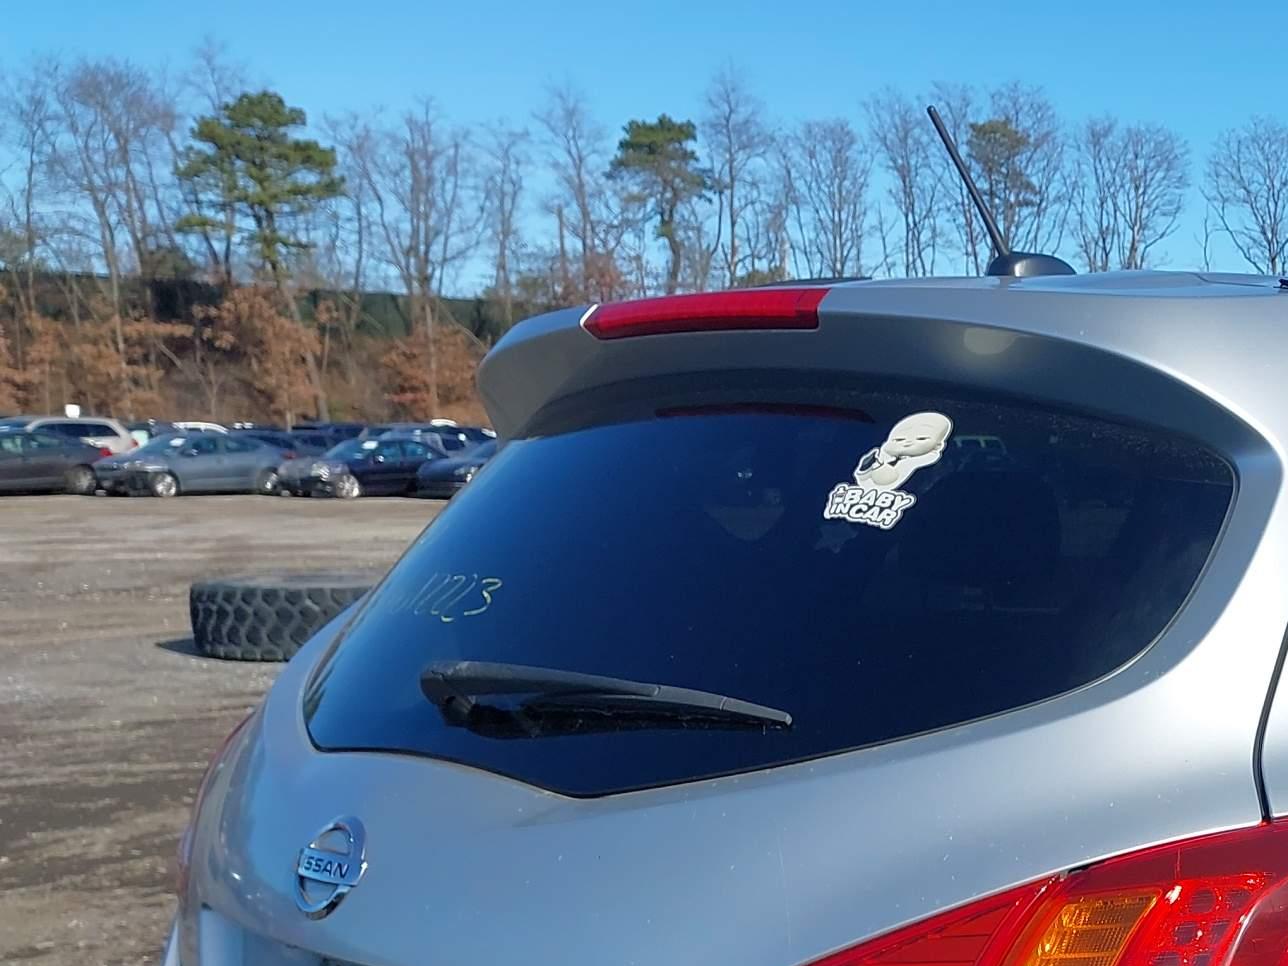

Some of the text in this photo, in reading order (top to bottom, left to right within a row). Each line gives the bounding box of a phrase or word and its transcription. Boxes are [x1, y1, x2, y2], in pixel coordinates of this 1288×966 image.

[842, 487, 912, 512] BABY
[829, 503, 900, 527] IN CAR
[303, 855, 351, 880] SSAN
